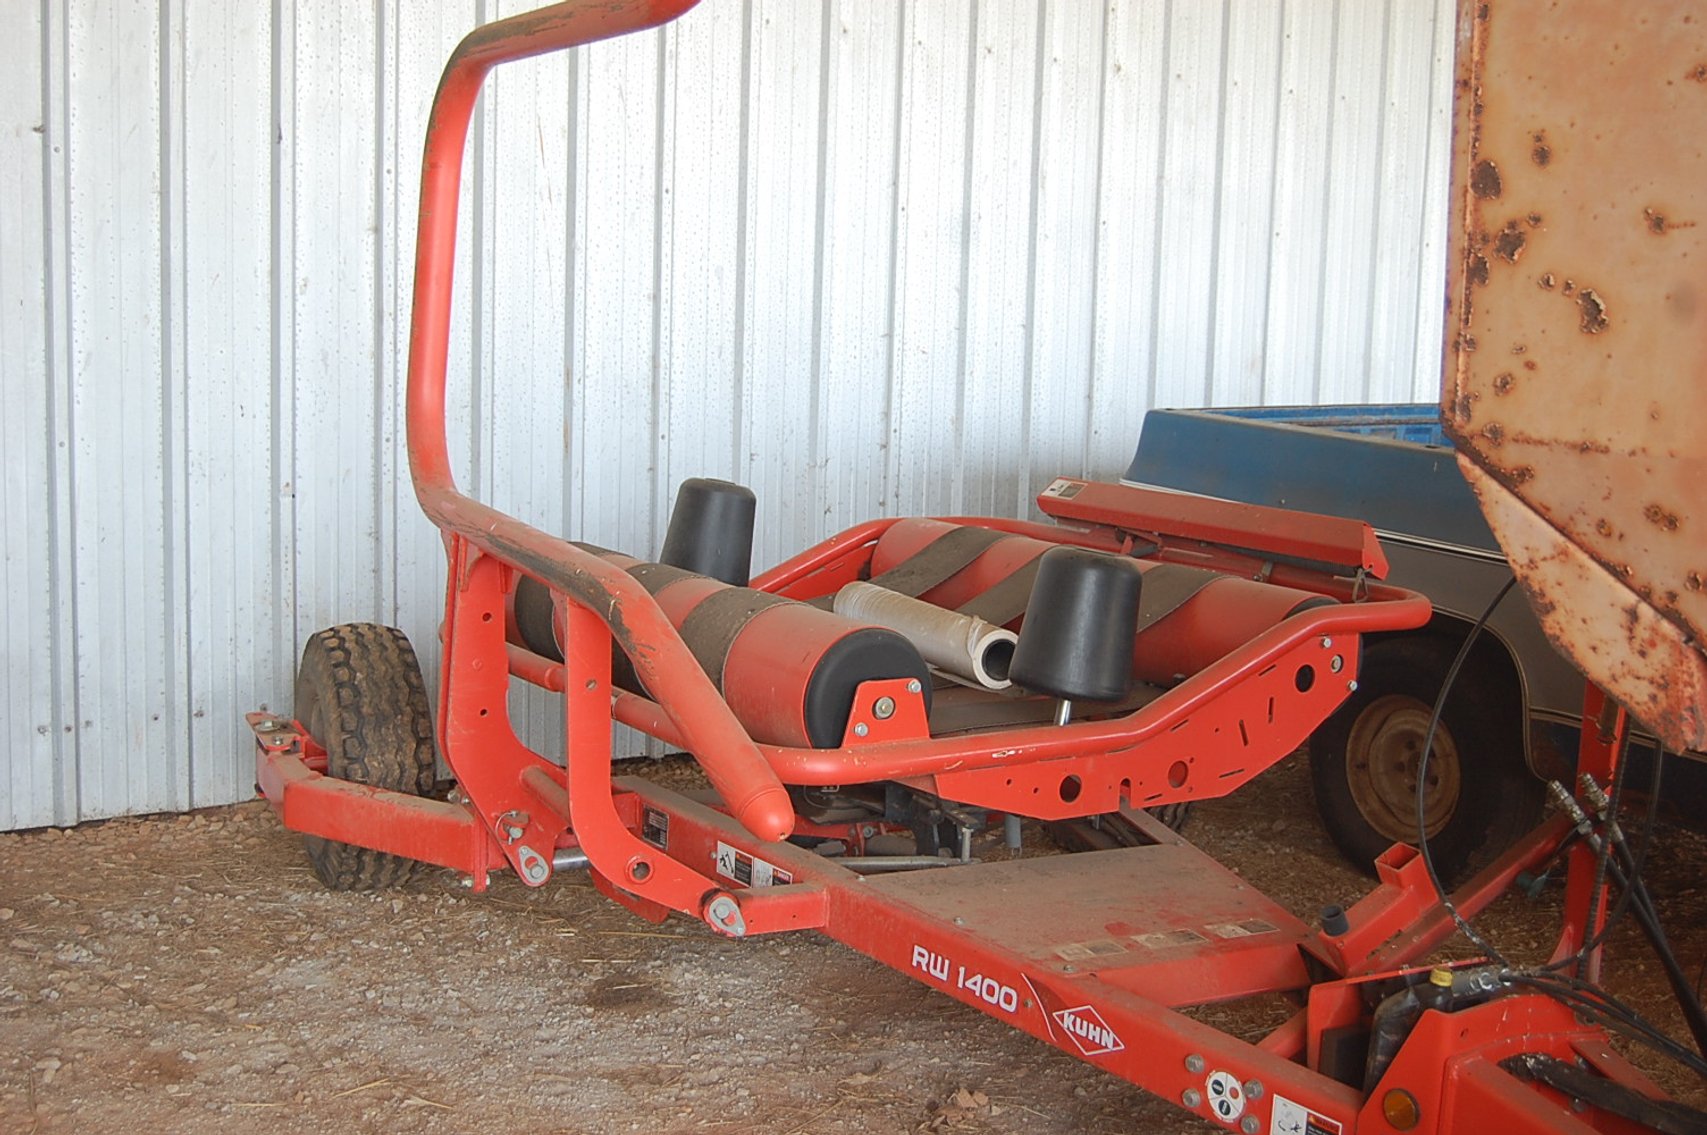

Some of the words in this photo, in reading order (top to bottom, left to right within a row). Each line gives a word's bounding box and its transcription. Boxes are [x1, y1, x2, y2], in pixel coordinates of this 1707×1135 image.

[911, 944, 950, 982] RW
[957, 966, 1018, 1013] 1400
[1063, 1012, 1114, 1049] KUHN
